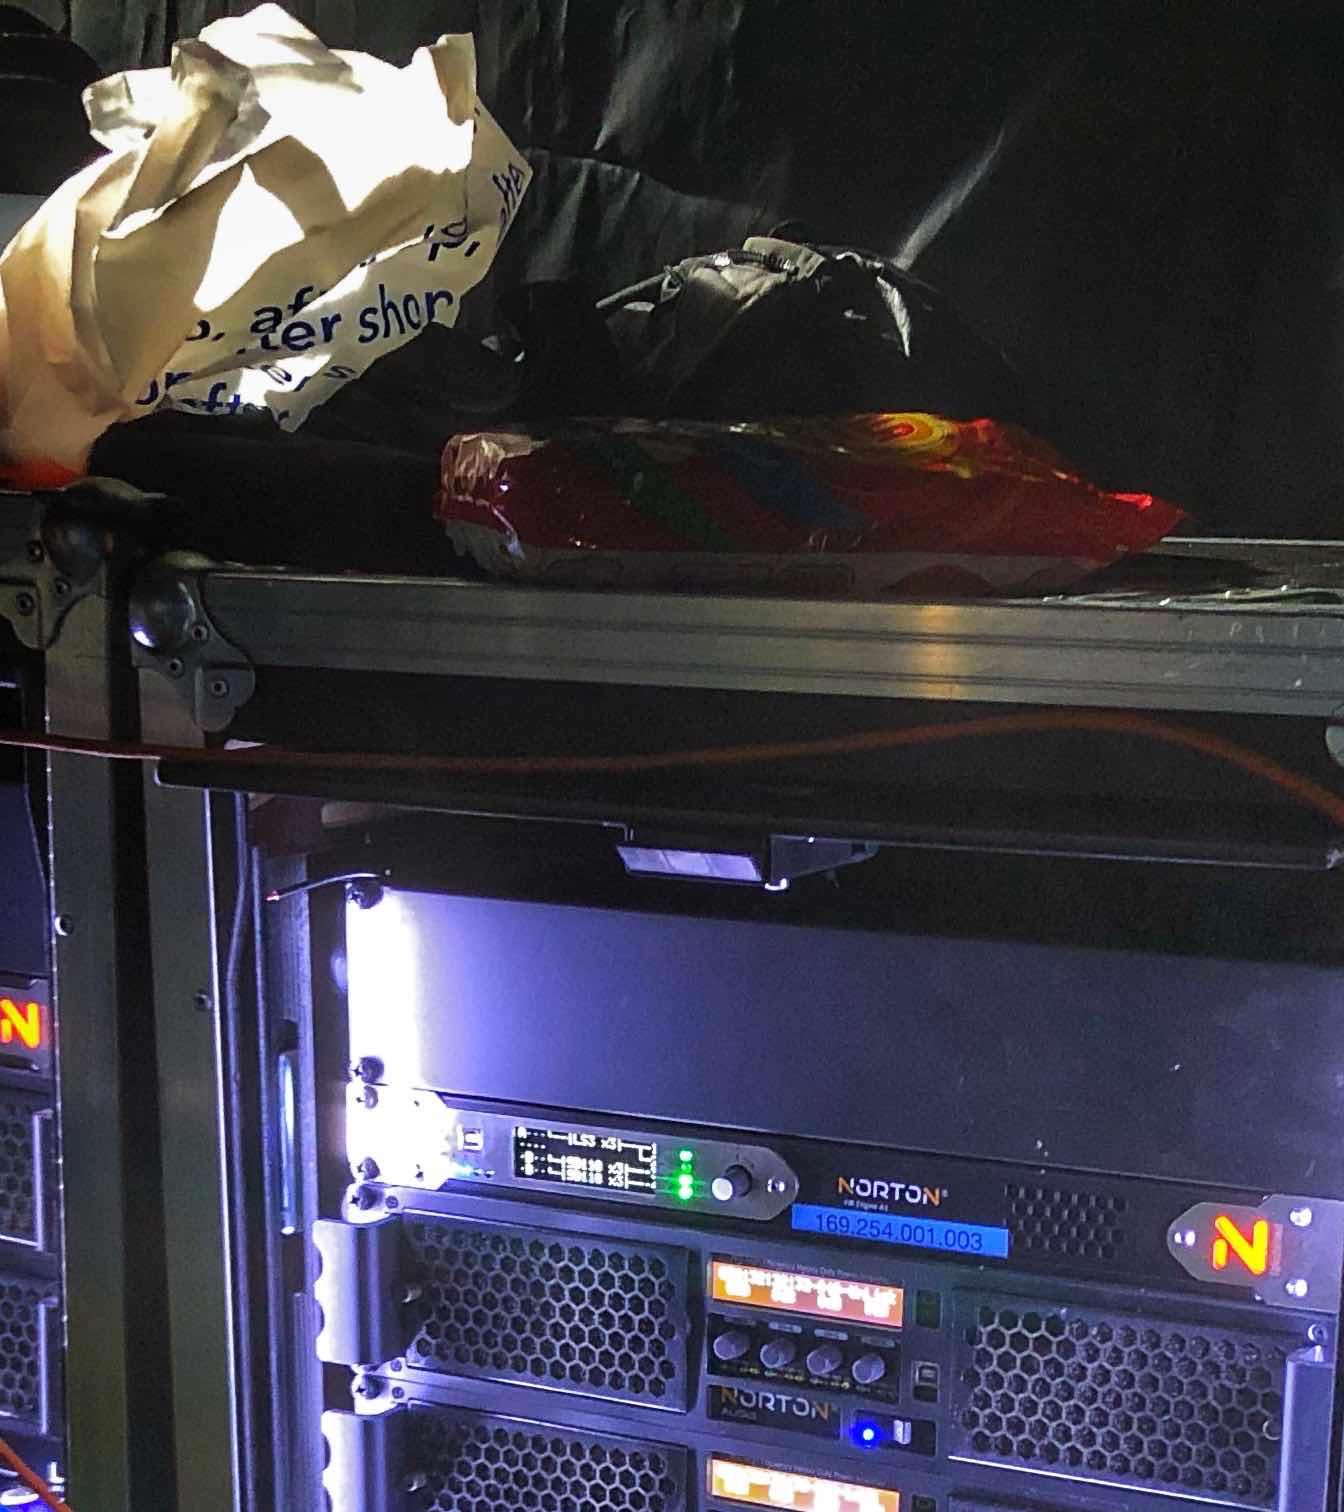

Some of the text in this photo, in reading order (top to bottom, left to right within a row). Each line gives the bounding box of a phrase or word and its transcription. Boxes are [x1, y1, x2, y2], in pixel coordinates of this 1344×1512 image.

[837, 1176, 942, 1208] NORTON
[816, 1213, 983, 1251] 169.254.001.003
[720, 1386, 831, 1423] NORTON
